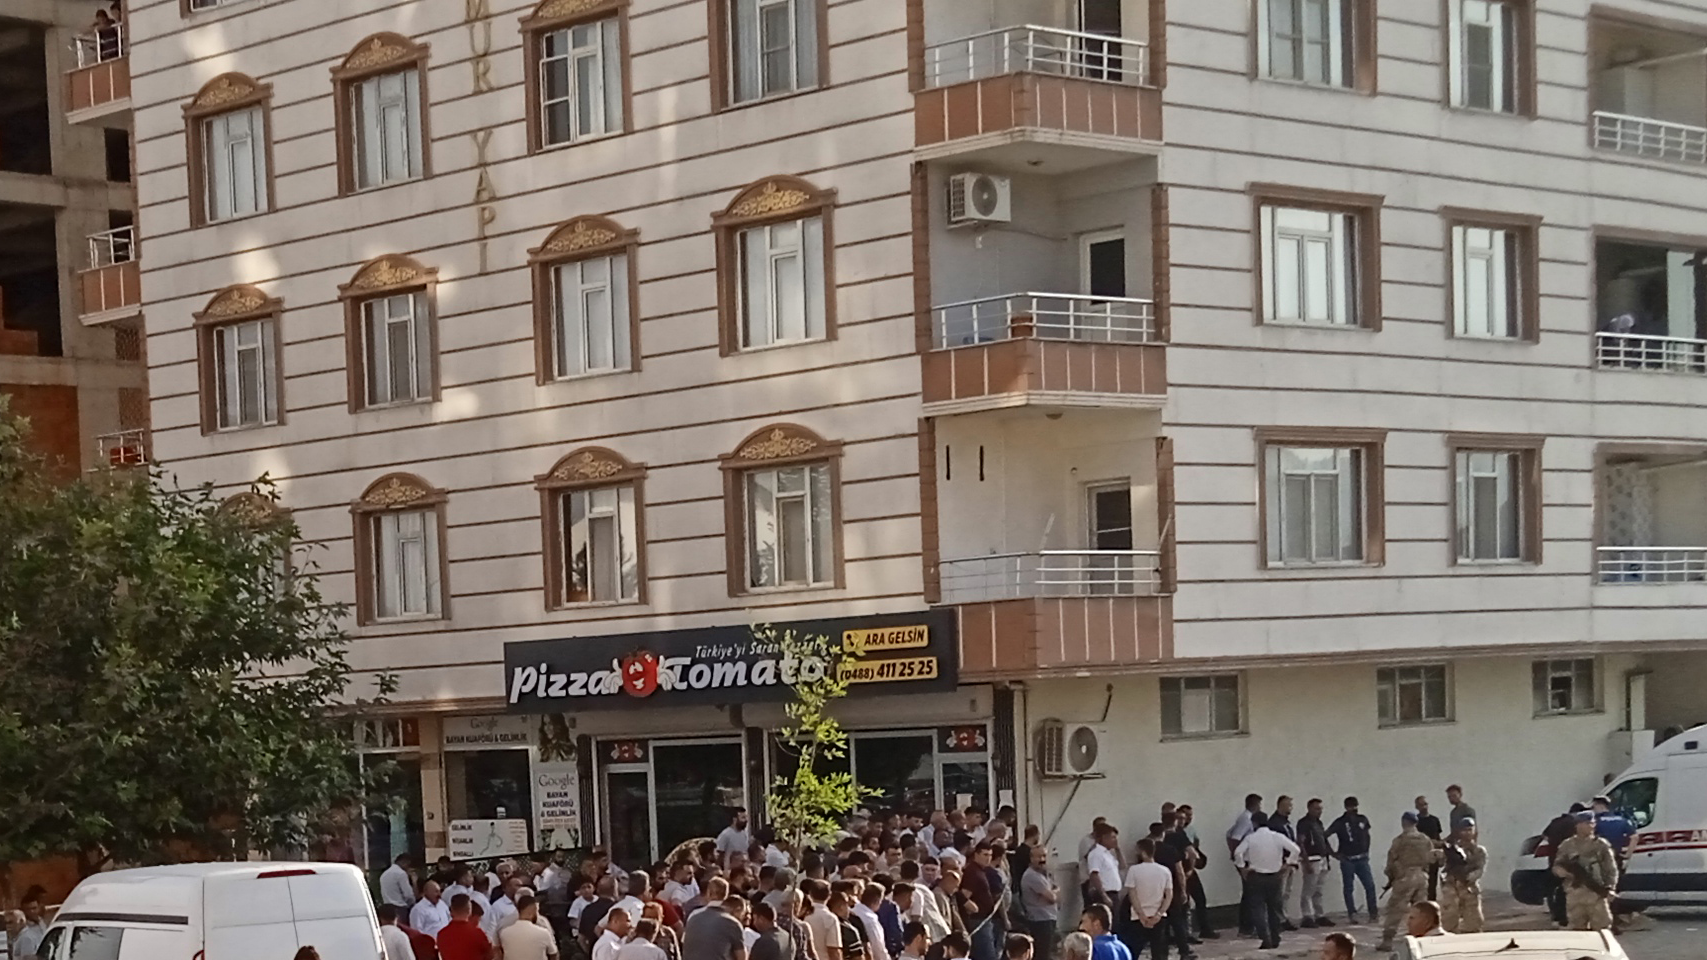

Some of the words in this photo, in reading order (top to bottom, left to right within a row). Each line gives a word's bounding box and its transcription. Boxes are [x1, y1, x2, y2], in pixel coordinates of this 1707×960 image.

[864, 632, 885, 646] ARA
[888, 627, 925, 645] GELSİN
[696, 643, 746, 659] Türkiye'yi
[877, 662, 897, 678] 411
[898, 661, 914, 677] 25
[917, 660, 933, 675] 25
[538, 773, 575, 790] Google
